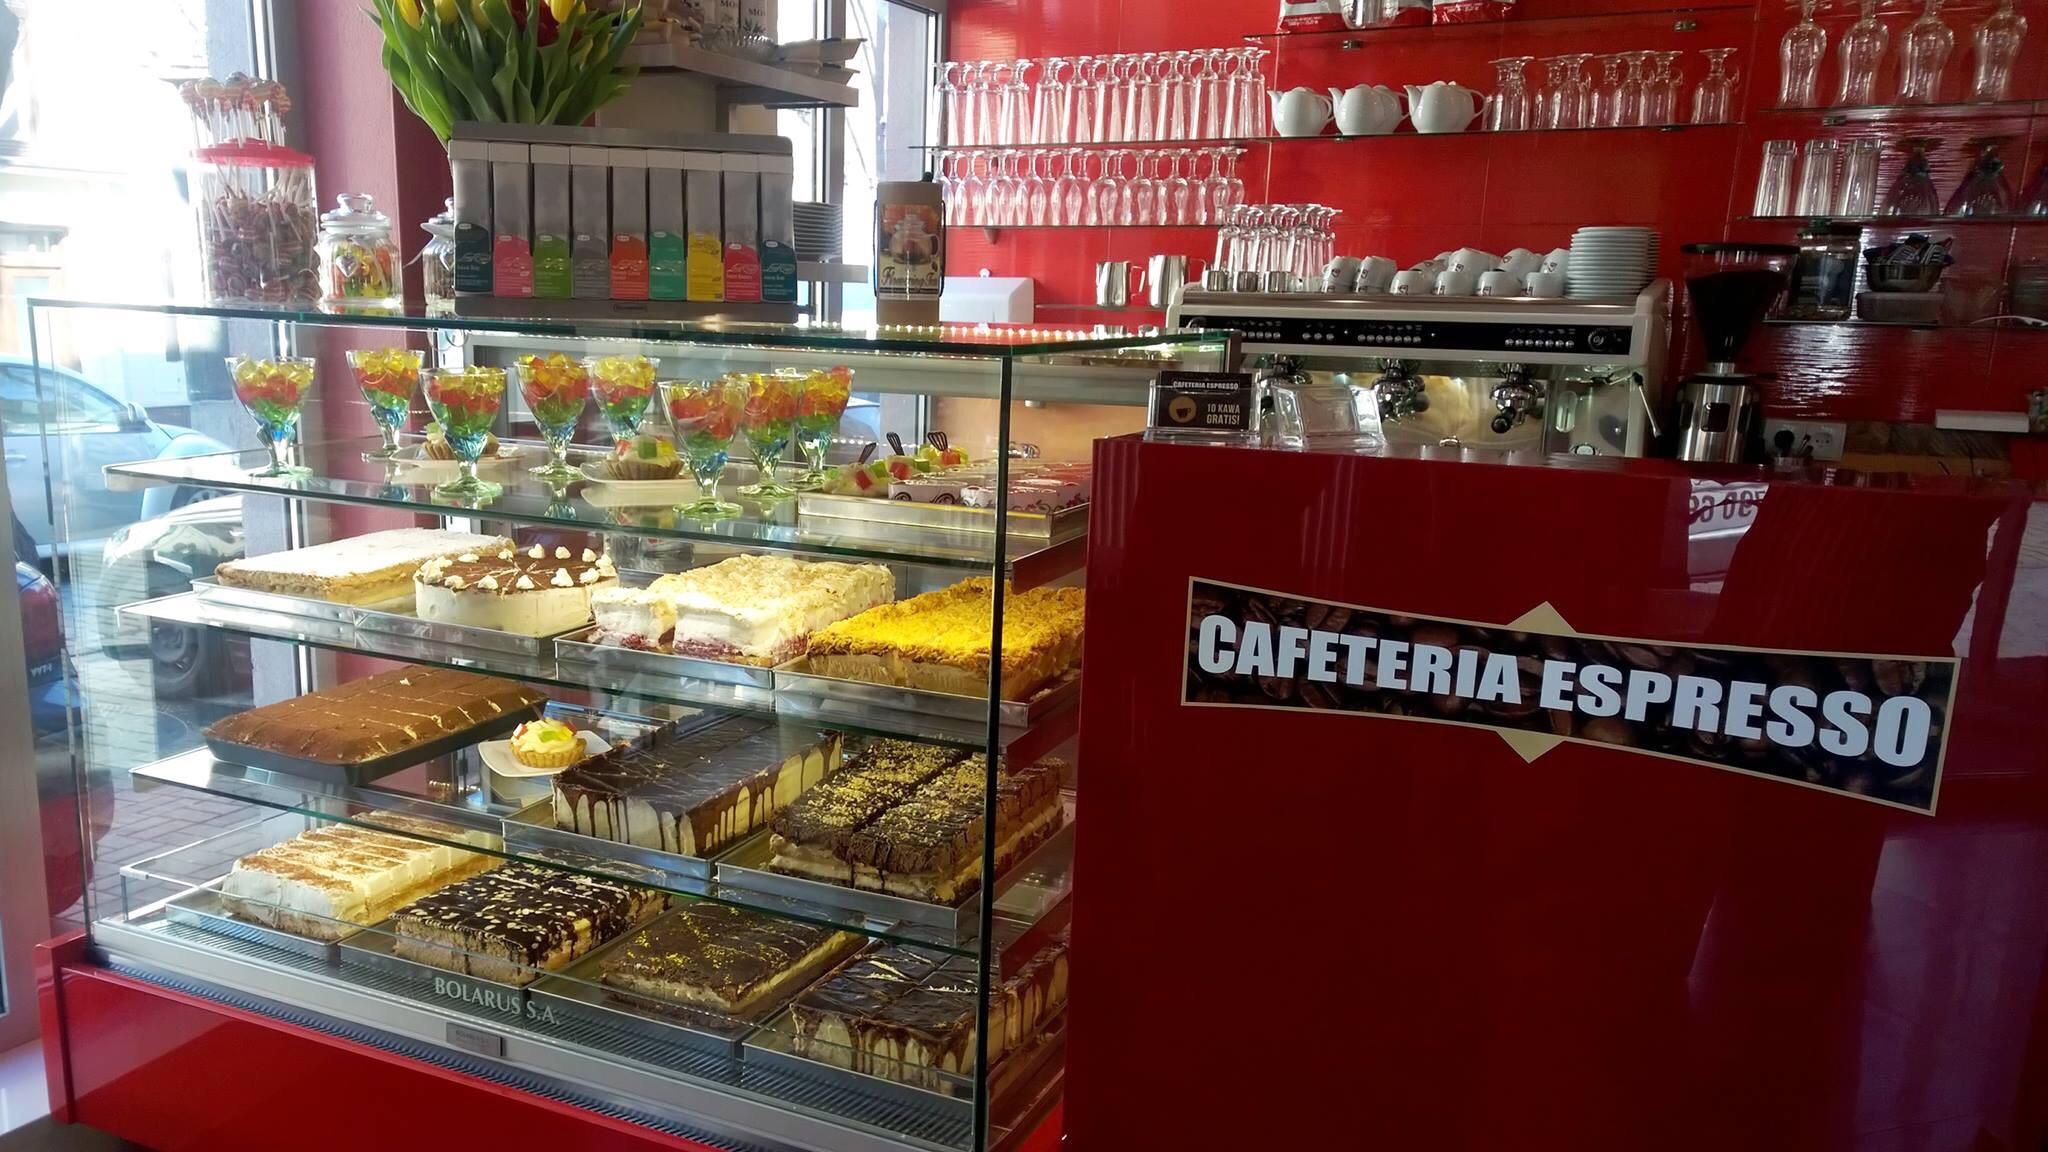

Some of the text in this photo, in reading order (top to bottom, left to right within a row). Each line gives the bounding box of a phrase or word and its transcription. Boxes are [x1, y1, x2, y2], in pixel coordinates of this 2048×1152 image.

[1206, 382, 1239, 390] ESPRESSO
[1207, 403, 1240, 413] 10 KAWA
[1206, 414, 1240, 425] GRATIS!
[1198, 614, 1932, 767] CAFETERIA ESPRESSO
[435, 977, 560, 1025] BOLARUS S.A.
